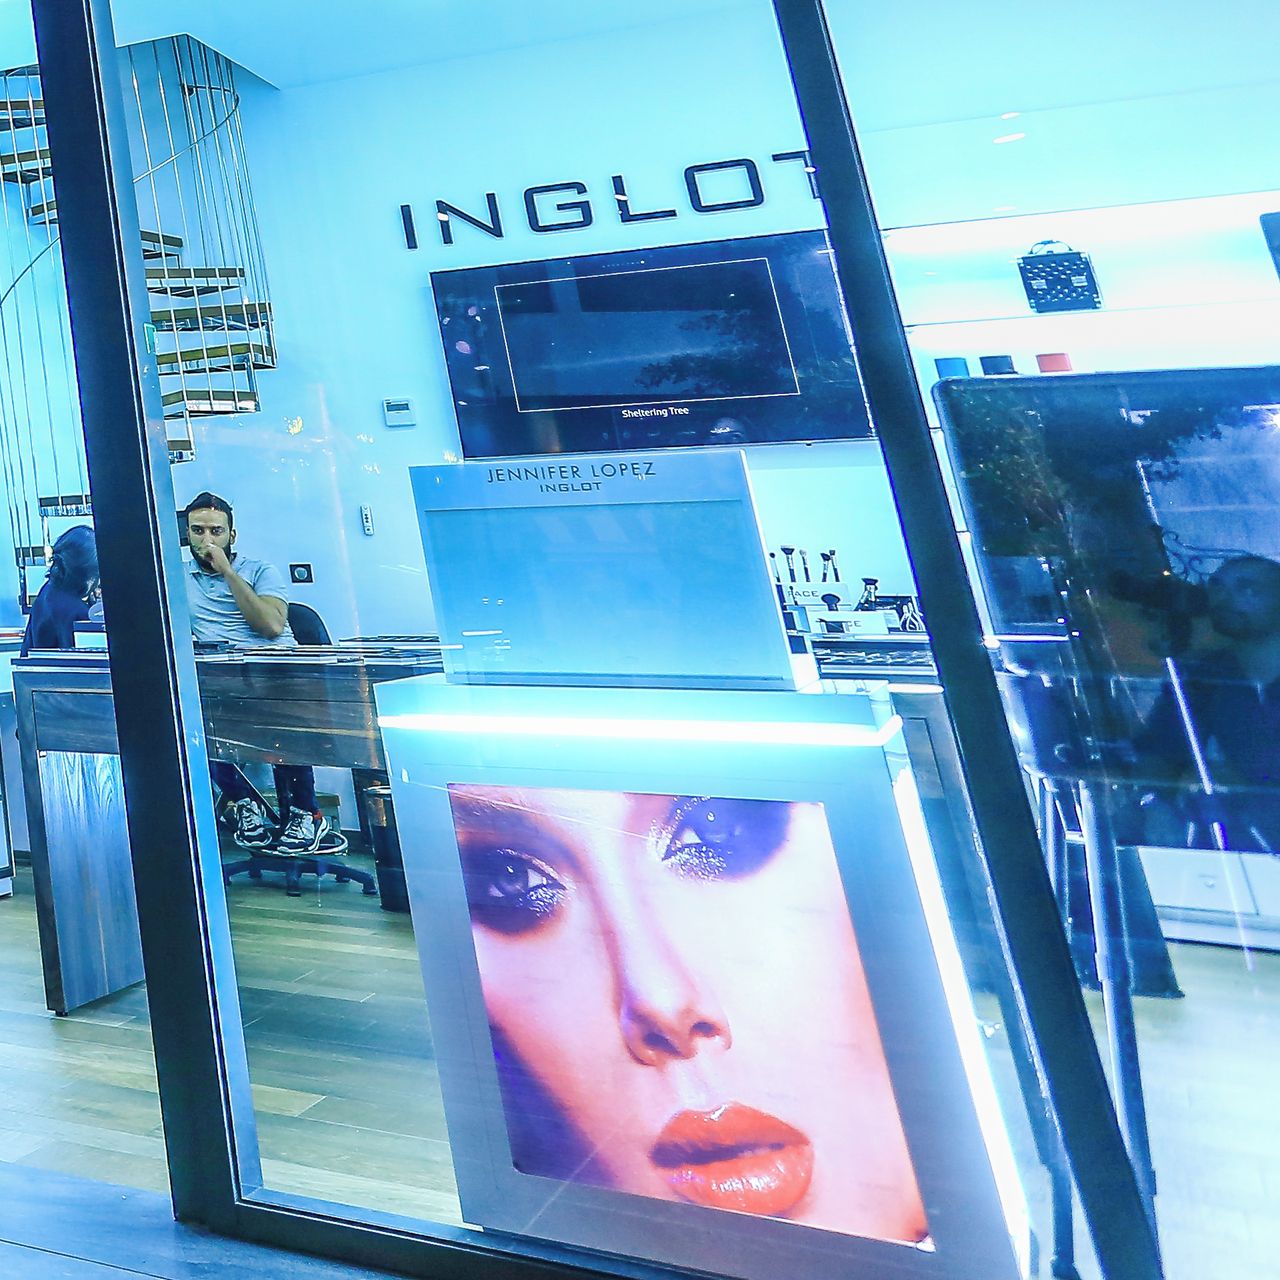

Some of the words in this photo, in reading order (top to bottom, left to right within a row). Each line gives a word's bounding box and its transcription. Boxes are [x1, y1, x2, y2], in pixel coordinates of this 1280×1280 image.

[621, 408, 668, 419] Sheltering
[669, 406, 690, 416] Tree
[487, 465, 580, 483] JENNIFER
[591, 462, 657, 479] LOPEZ
[540, 481, 602, 493] INGLOT
